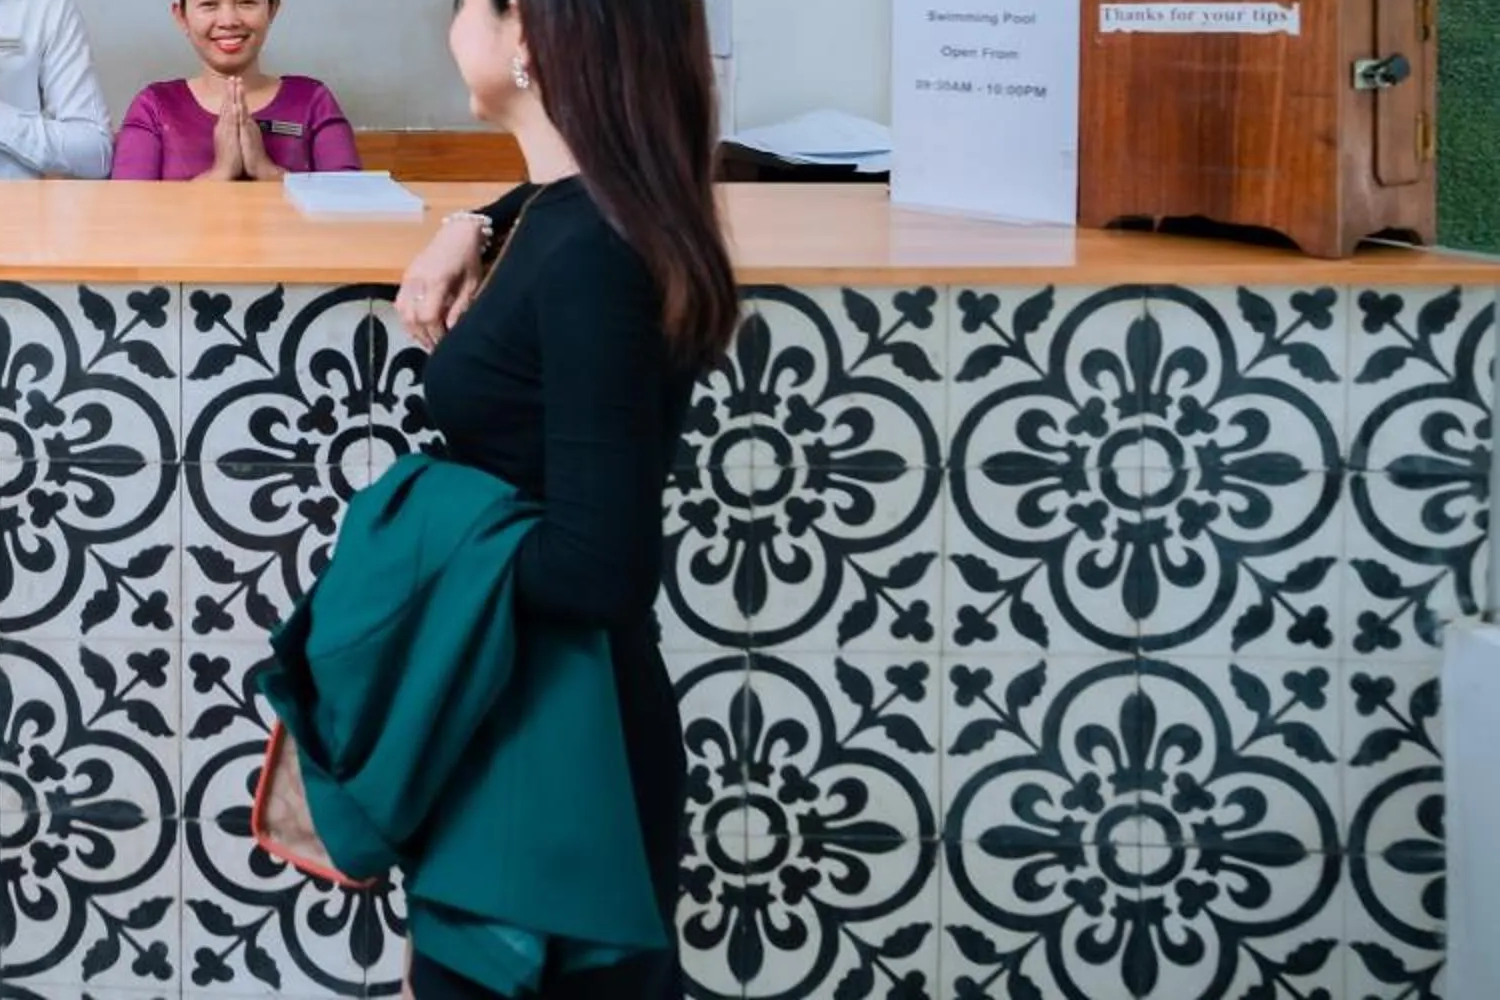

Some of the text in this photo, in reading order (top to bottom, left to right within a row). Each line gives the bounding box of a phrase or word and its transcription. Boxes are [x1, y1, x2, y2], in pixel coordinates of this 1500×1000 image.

[1002, 11, 1036, 24] Pool
[1104, 7, 1288, 27] Thanks for your tips
[940, 45, 1019, 60] Open From
